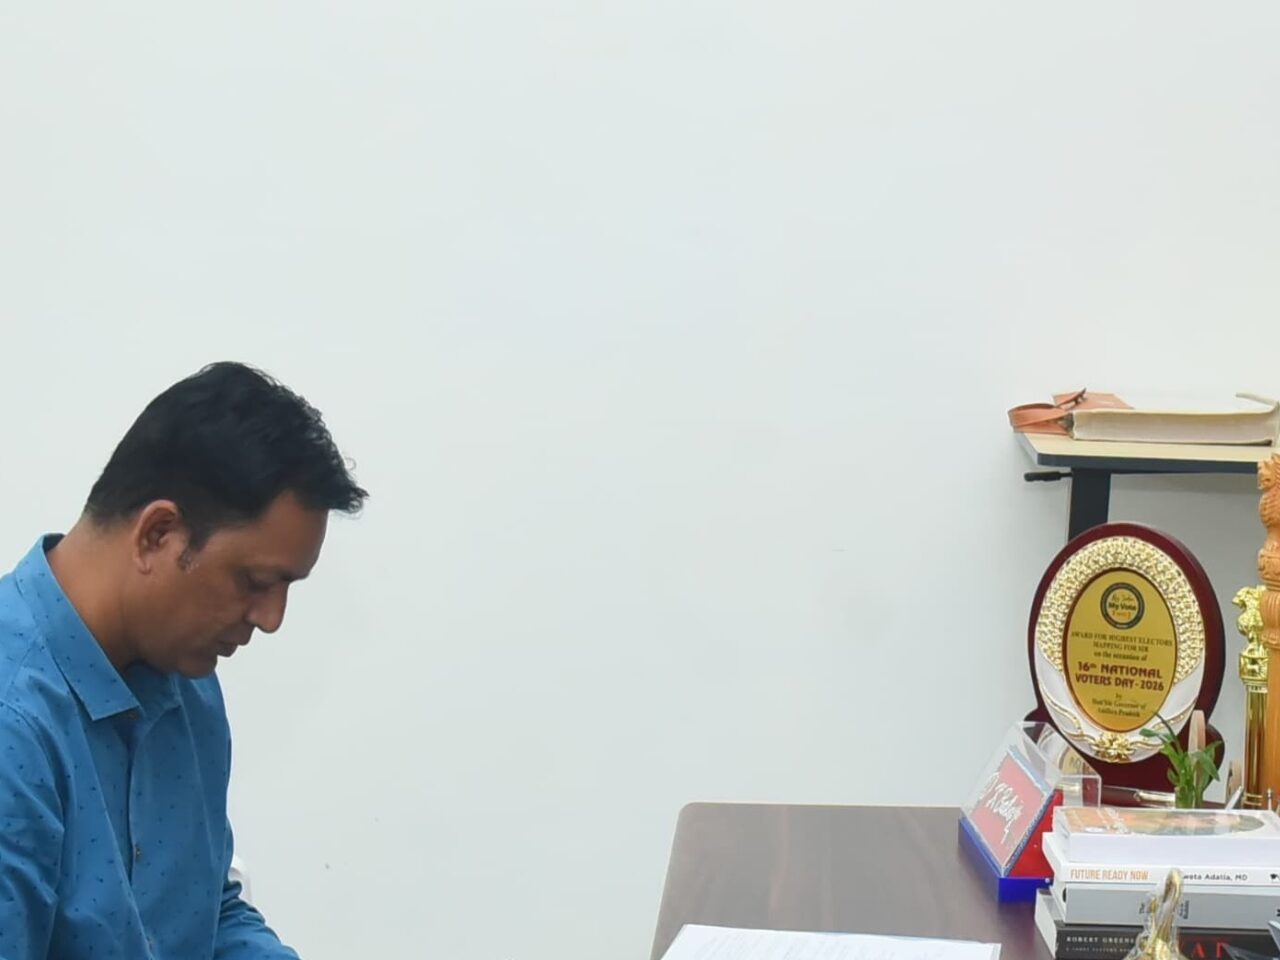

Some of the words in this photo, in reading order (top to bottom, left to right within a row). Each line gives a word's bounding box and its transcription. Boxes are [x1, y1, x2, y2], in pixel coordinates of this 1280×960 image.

[1120, 603, 1136, 611] Vote
[1101, 664, 1162, 679] NATIONAL
[1075, 673, 1112, 686] VOTERS
[1070, 868, 1101, 880] FUTURE
[1102, 869, 1128, 880] READY
[1130, 870, 1149, 881] NOW
